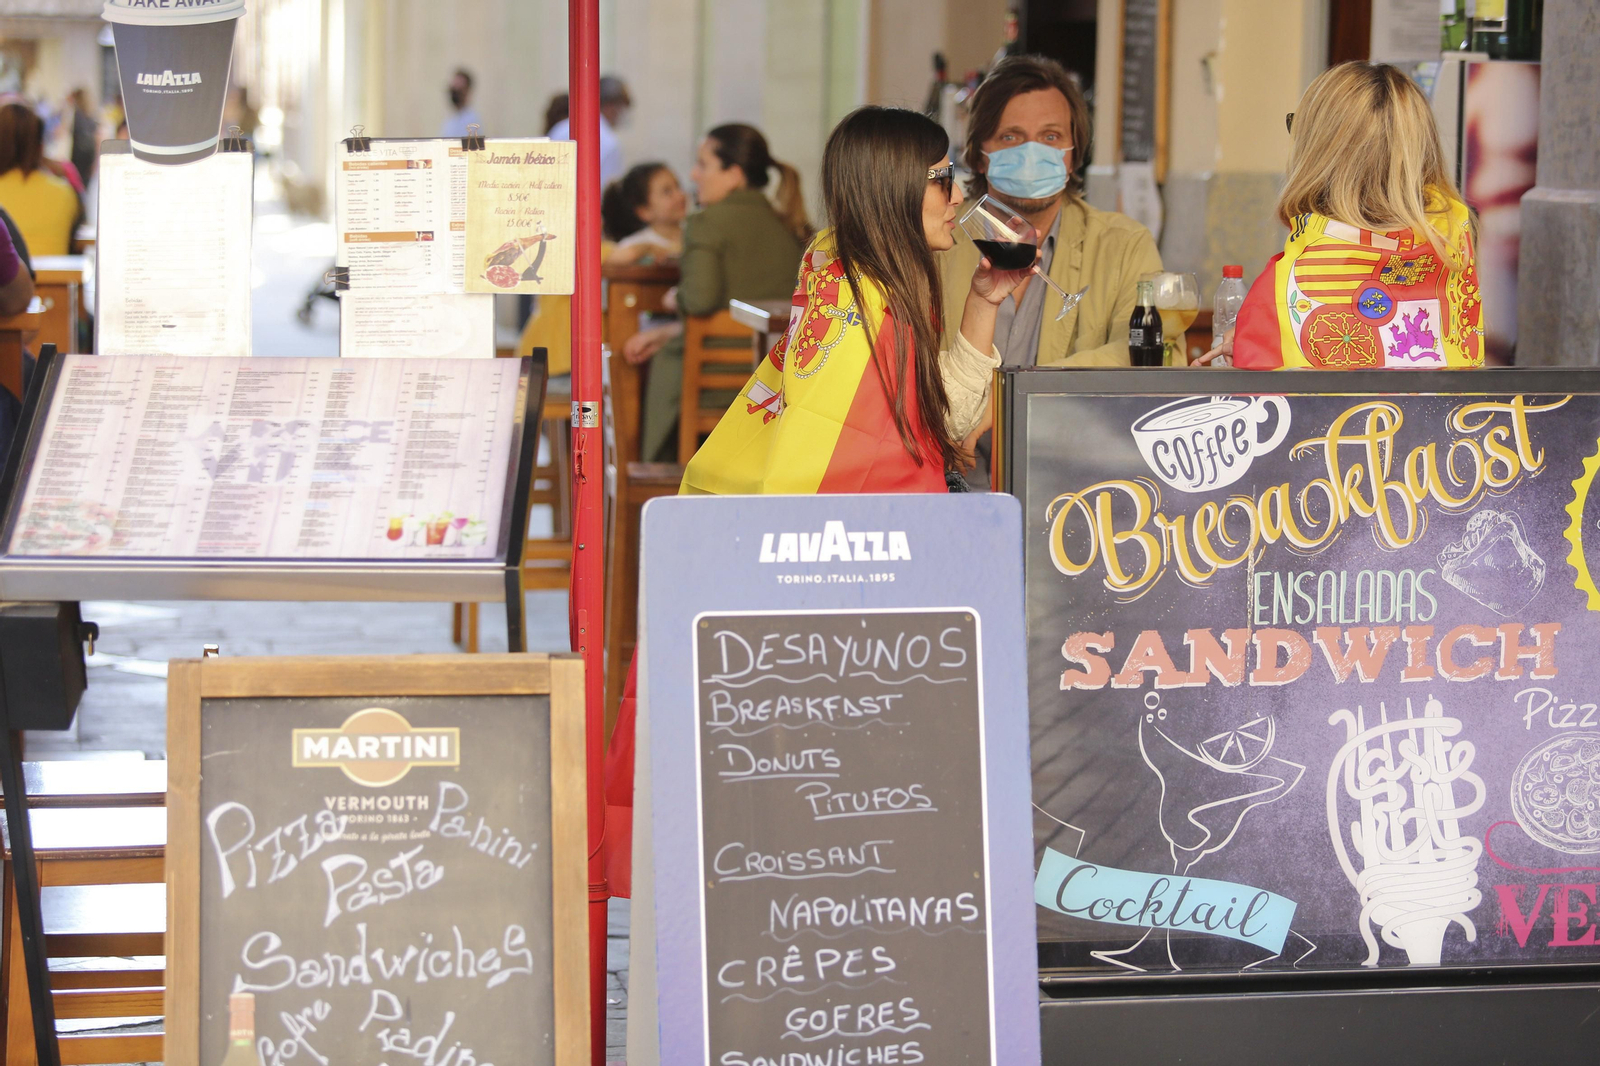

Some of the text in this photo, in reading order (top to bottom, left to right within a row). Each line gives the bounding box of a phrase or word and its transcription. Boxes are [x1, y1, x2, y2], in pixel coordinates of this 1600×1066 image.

[175, 0, 221, 8] AWA
[136, 70, 202, 86] LAVAZZA
[486, 151, 556, 165] Jamón Ibérico
[1399, 239, 1411, 252] PL
[1049, 395, 1572, 592] Breakfast
[759, 520, 912, 563] LAVAZZA
[1254, 569, 1438, 625] ENSALADAS
[711, 627, 967, 679] DESAYUNOS
[1060, 623, 1562, 691] SANDWICH
[1513, 687, 1600, 730] Pizz
[302, 735, 449, 760] MARTINI
[718, 743, 841, 777] DONUTS
[324, 795, 429, 812] VERMOUTH
[343, 814, 384, 824] ORINO
[205, 781, 537, 898] Pizza Panini
[321, 844, 444, 928] Pasta
[1056, 863, 1268, 938] Cocktail
[1492, 884, 1600, 948] VE
[233, 922, 533, 993] Sandwiches
[717, 945, 897, 988] CRÊPES
[785, 997, 920, 1032] GOFRES
